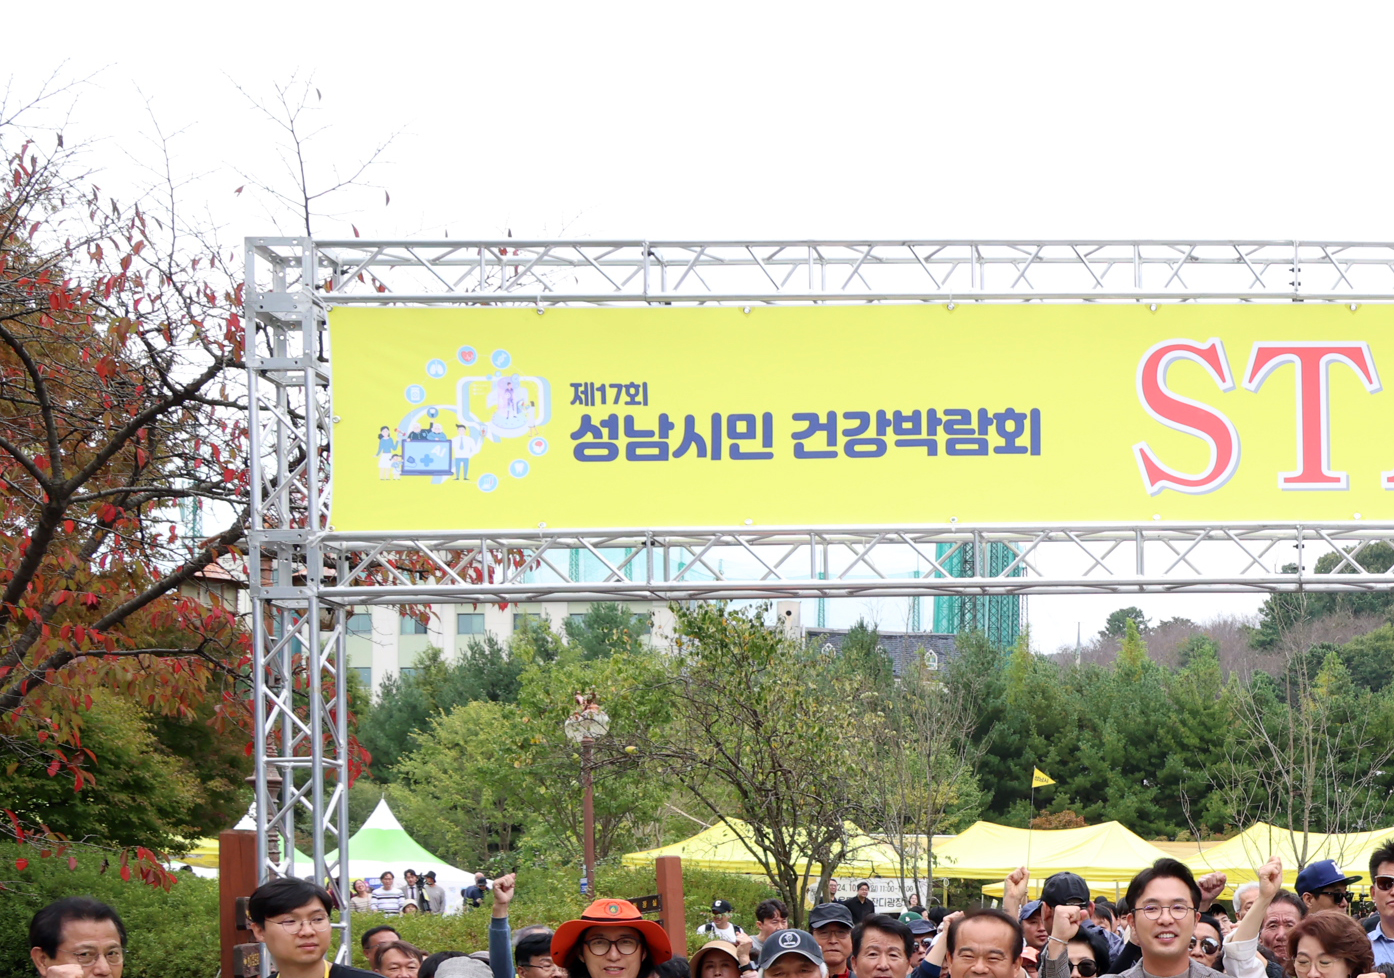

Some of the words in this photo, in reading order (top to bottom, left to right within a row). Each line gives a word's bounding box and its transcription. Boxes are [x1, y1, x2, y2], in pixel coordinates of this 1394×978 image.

[569, 381, 649, 407] 제17회
[569, 411, 775, 463] 성남시민
[790, 407, 1041, 460] 건강박람회
